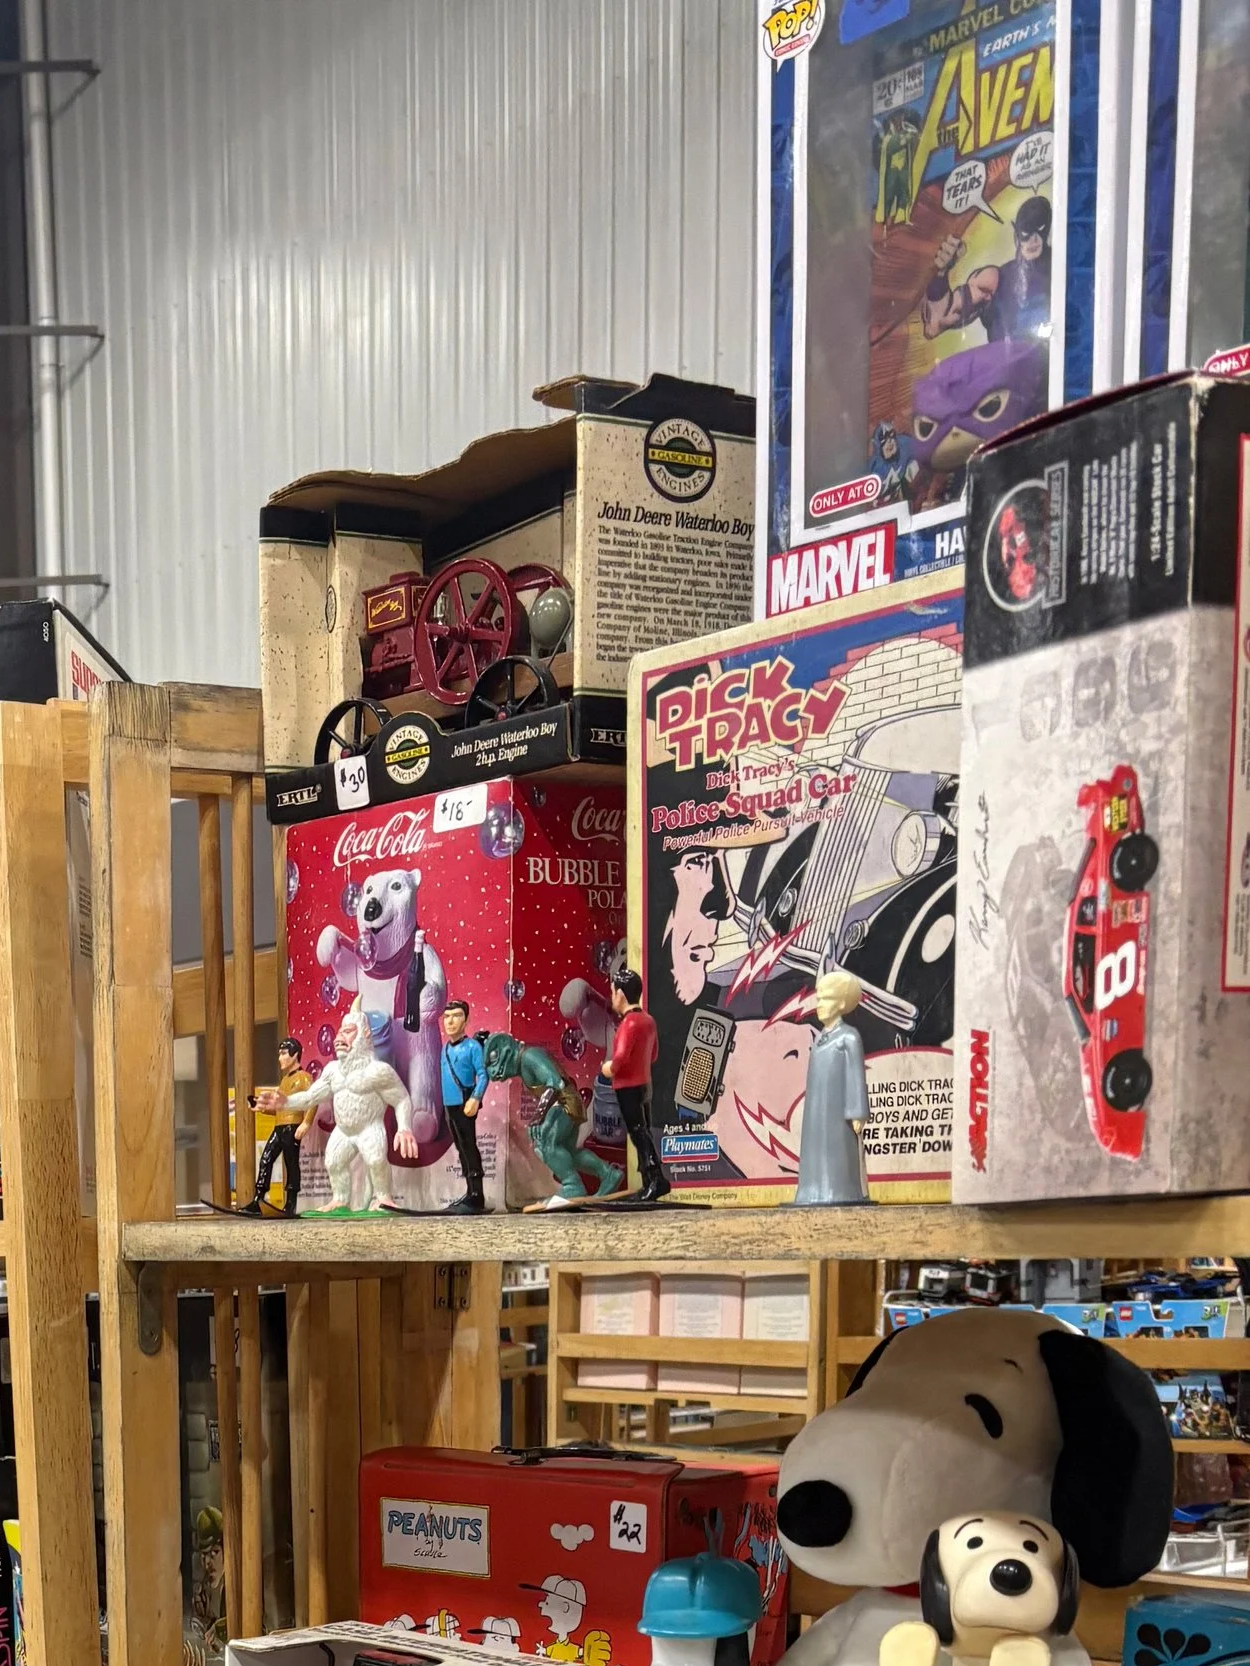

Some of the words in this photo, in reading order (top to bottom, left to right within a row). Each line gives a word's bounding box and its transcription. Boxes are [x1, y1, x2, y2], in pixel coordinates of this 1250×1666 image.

[655, 422, 707, 447] VINTAGE
[657, 450, 704, 466] GASOLINE
[655, 467, 705, 493] ENGINES
[813, 489, 845, 512] ONLY
[847, 484, 863, 501] AT
[597, 501, 631, 520] John
[634, 506, 672, 527] Deere
[674, 511, 730, 535] Waterloo
[731, 518, 755, 541] Boy
[770, 528, 891, 616] MARVEL
[668, 682, 851, 768] TRACY
[386, 729, 425, 752] VINTAGE
[451, 741, 474, 760] John
[473, 736, 500, 755] Deere
[500, 727, 540, 751] Waterloo
[539, 721, 558, 742] Boy
[390, 748, 425, 763] GASOLINE
[497, 744, 529, 764] Engine
[391, 758, 427, 782] ENGINES
[706, 770, 742, 792] Dick
[743, 757, 796, 785] Tracy's
[276, 786, 319, 808] ERTL
[652, 798, 721, 834] Police
[725, 782, 804, 822] Squad
[808, 772, 858, 801] Car
[663, 828, 715, 852] Powerful
[715, 823, 750, 841] Police
[527, 856, 621, 887] BUBBLE
[1094, 941, 1137, 1011] 8
[898, 1081, 925, 1093] DICK
[896, 1095, 924, 1107] DICK
[902, 1109, 929, 1122] AND
[663, 1123, 684, 1136] Ages
[882, 1124, 935, 1139] TAKING
[664, 1136, 716, 1155] Playmates
[387, 1510, 483, 1543] PEANUTS
